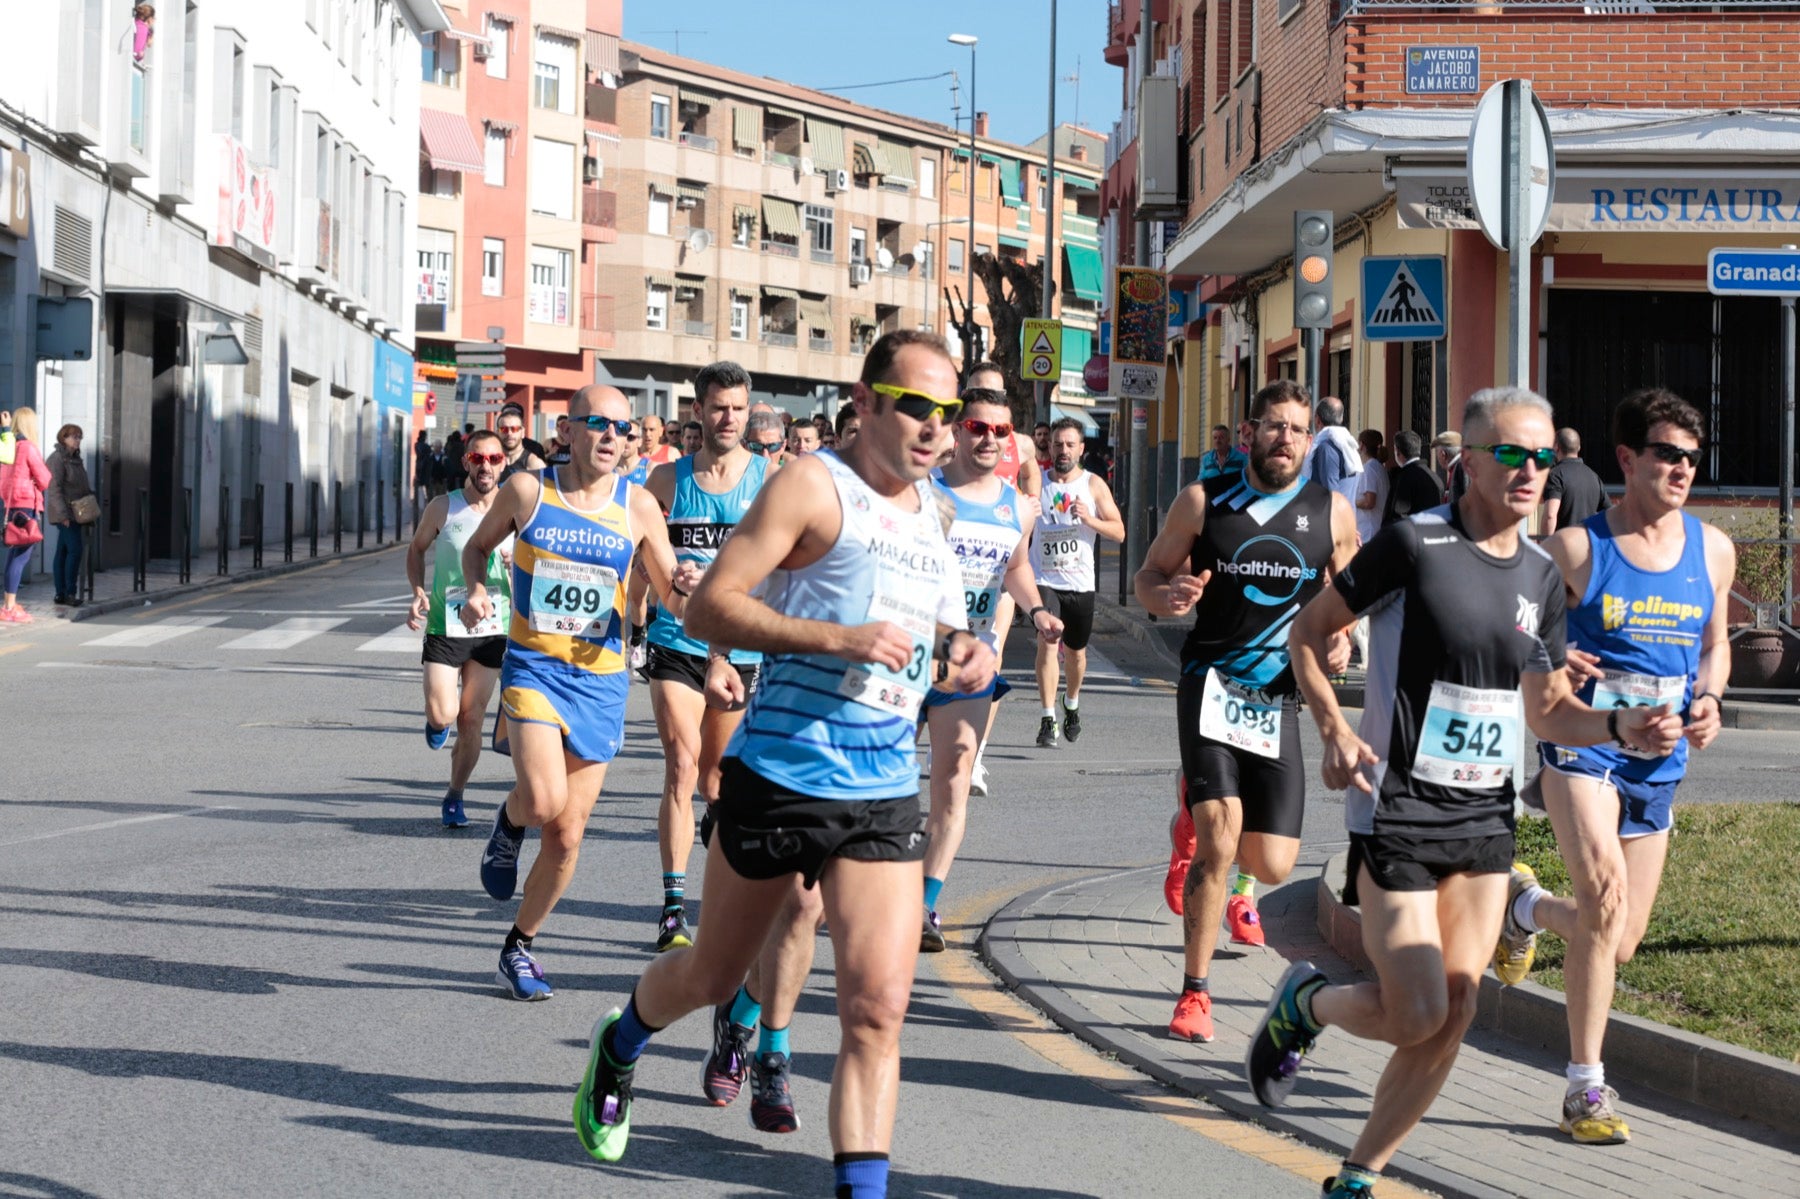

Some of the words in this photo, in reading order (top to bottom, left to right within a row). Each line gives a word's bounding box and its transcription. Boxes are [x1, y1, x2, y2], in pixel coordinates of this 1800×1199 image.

[1423, 49, 1476, 61] AVENIDA
[1427, 61, 1471, 75] JACOBO
[1410, 76, 1476, 90] CAMARERO
[1427, 186, 1470, 197] TOLDO
[1425, 197, 1463, 208] Santa
[1464, 198, 1472, 208] F
[1591, 188, 1800, 222] RESTAUR
[1716, 263, 1800, 282] Granad
[1036, 361, 1048, 369] 20
[534, 526, 625, 552] agustinos
[1043, 539, 1078, 557] 3100
[547, 544, 612, 559] GRANADA
[1216, 558, 1318, 580] healthiness
[544, 584, 600, 614] 499
[964, 590, 990, 614] 98
[1631, 595, 1703, 621] olimpo
[1224, 700, 1276, 736] 098
[1442, 718, 1502, 758] 542
